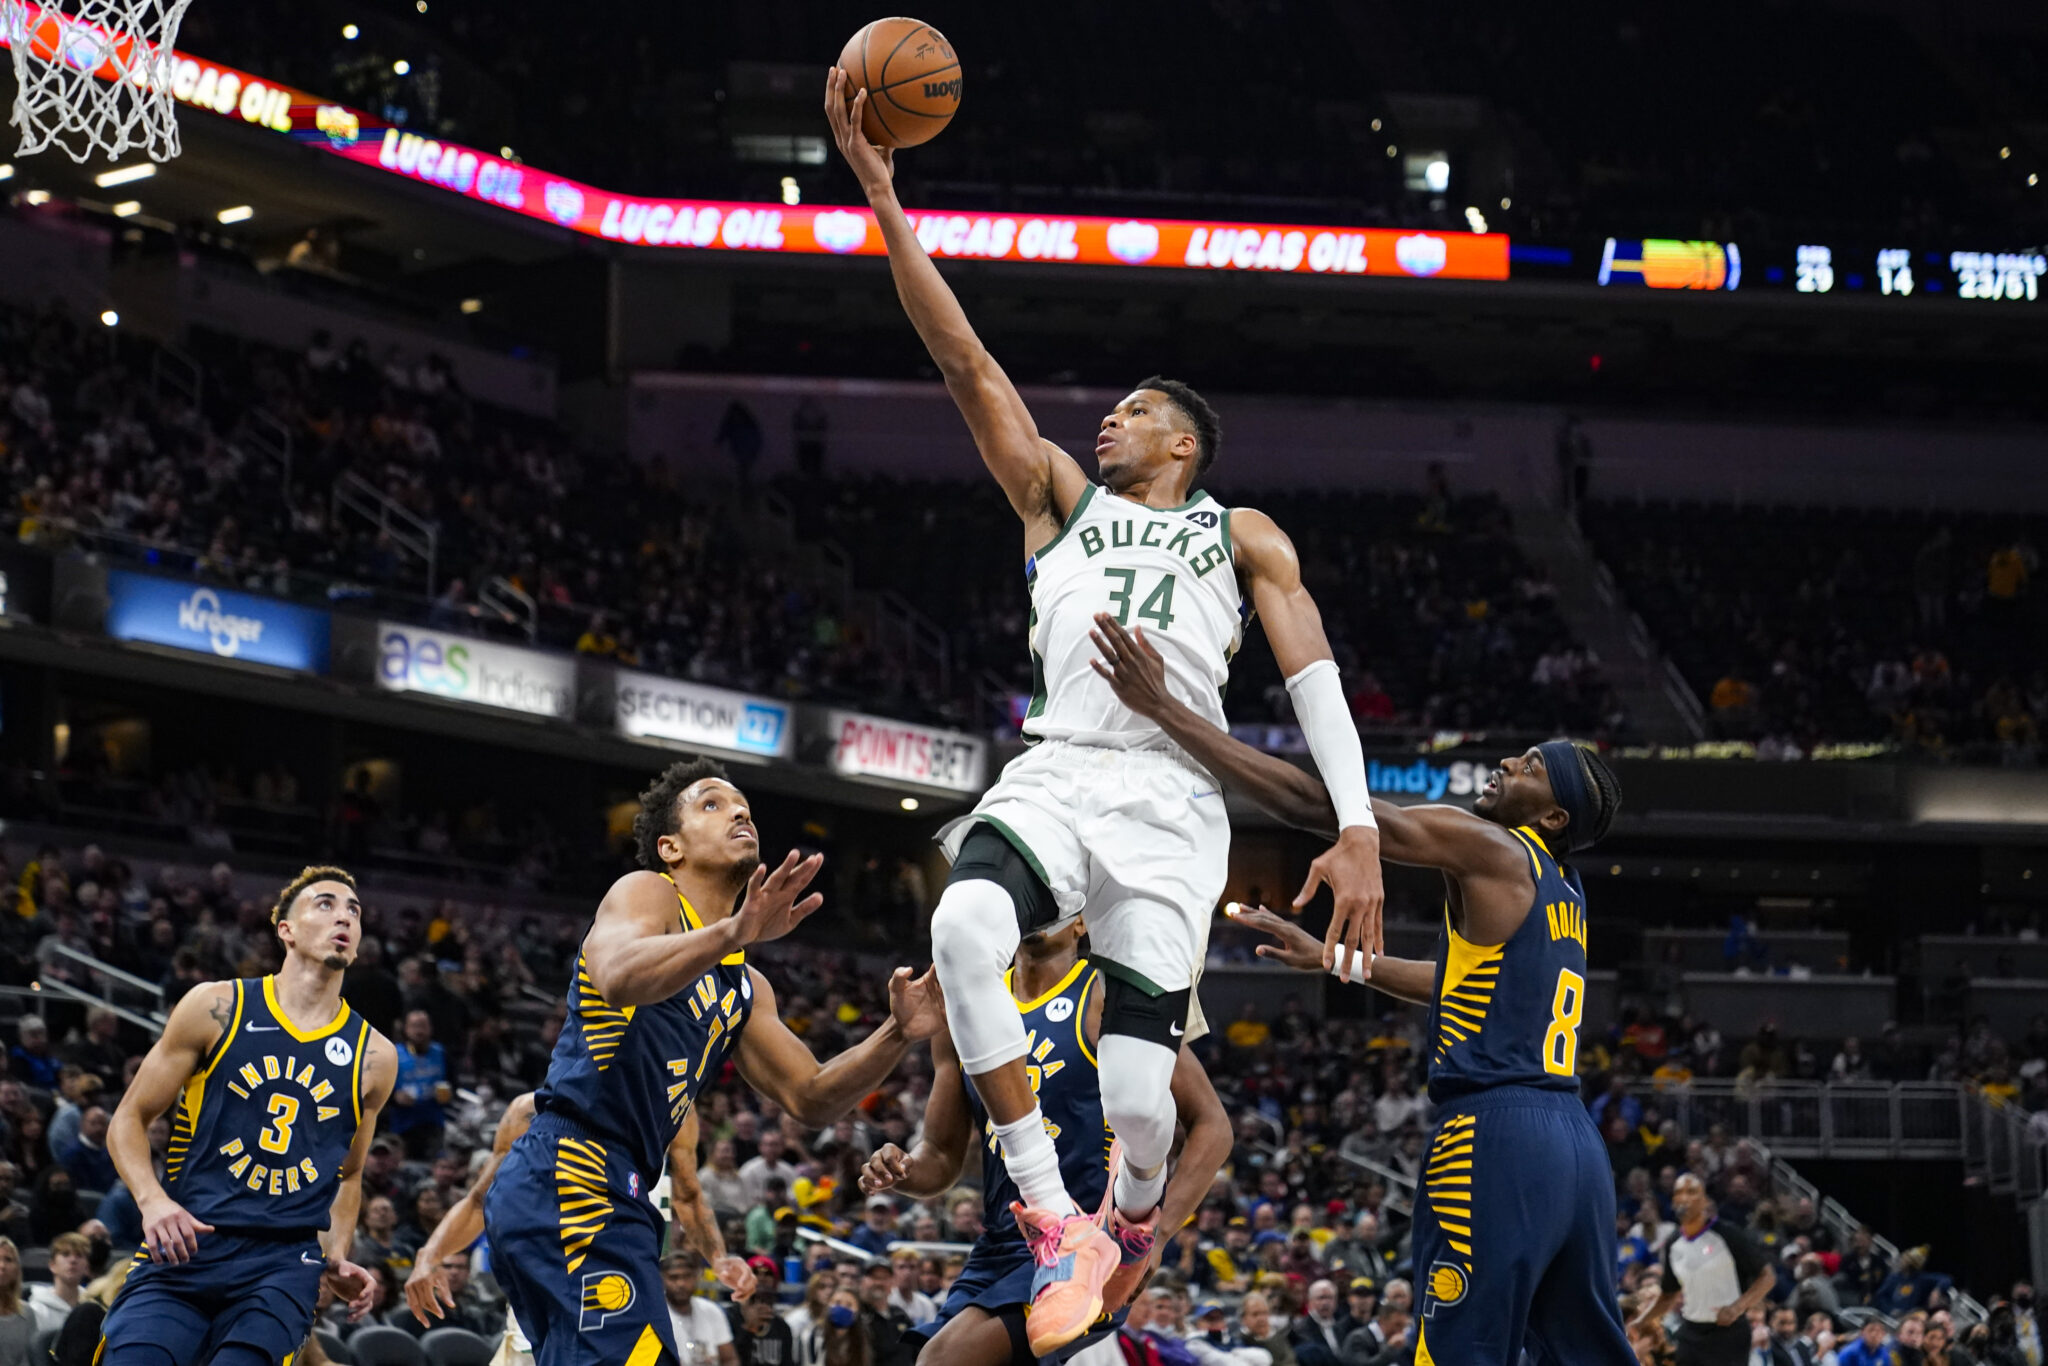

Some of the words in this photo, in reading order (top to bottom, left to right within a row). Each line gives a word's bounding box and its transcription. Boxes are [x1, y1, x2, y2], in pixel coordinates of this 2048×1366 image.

[240, 82, 292, 133] OIL
[379, 128, 478, 193] LUCAS
[477, 160, 525, 209] OIL
[600, 201, 722, 247] LUCAS
[722, 209, 784, 249] OIL
[1017, 219, 1079, 260] OIL
[1184, 227, 1307, 271] LUCAS
[1308, 232, 1368, 274] OIL
[1079, 519, 1227, 579] BUCKS
[179, 587, 264, 657] Kroger
[1103, 567, 1177, 631] 34
[382, 631, 470, 695] aes
[620, 685, 735, 730] SECTION
[837, 719, 973, 781] POINTSBET
[1368, 757, 1490, 801] IndySt
[694, 1014, 725, 1082] 7
[1543, 967, 1585, 1077] 8
[227, 1055, 340, 1122] INDIANA
[258, 1092, 300, 1155] 3
[219, 1137, 318, 1196] PACERS
